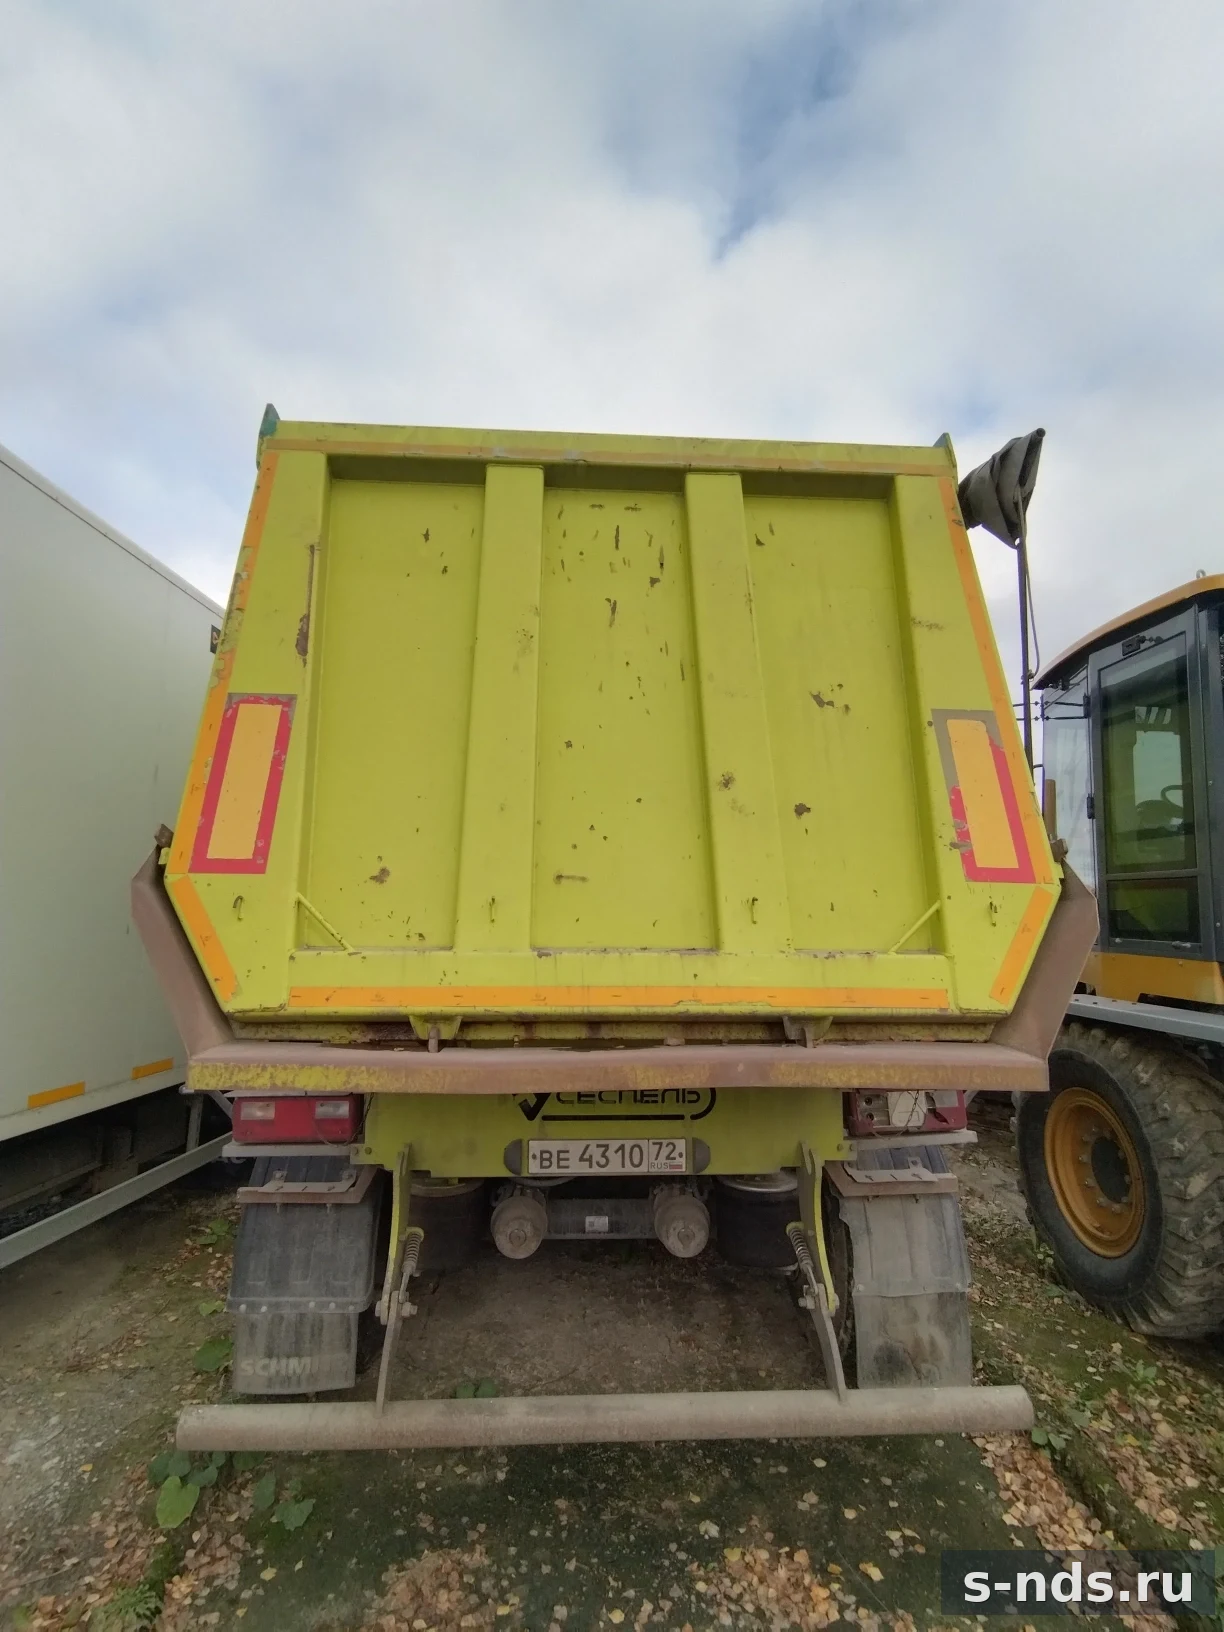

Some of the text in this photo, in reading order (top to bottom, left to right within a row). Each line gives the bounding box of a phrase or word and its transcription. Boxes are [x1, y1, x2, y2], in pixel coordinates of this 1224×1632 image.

[578, 1142, 645, 1170] 4310
[651, 1141, 677, 1161] 72
[650, 1161, 669, 1170] RUS
